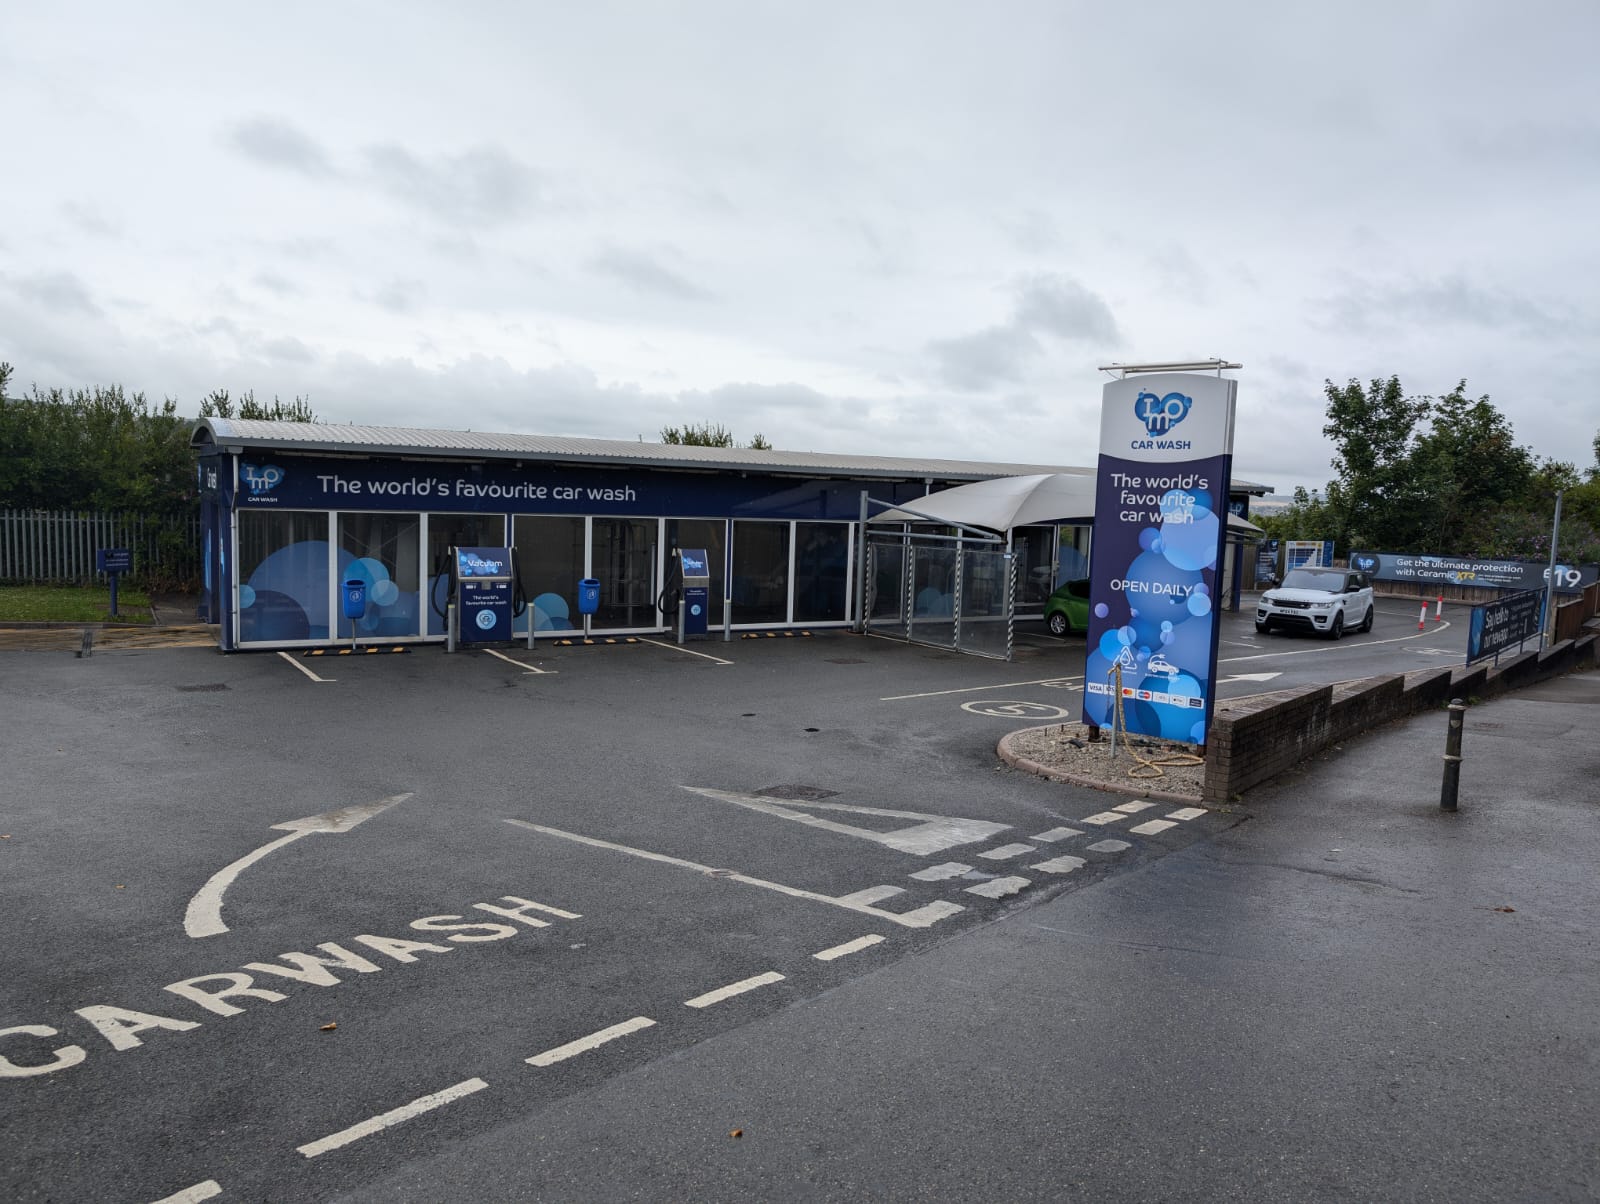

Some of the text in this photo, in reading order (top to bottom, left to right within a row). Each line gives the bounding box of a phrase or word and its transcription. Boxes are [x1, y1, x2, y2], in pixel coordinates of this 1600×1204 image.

[1131, 440, 1191, 449] CAR WASH
[317, 474, 636, 501] The world's favourite car wash
[1110, 473, 1208, 489] The world's
[1120, 490, 1196, 507] favourite
[1120, 510, 1194, 524] car wash
[1396, 558, 1413, 567] Get
[1431, 561, 1471, 570] ultimate
[1472, 564, 1524, 573] protection
[1395, 568, 1415, 576] with
[1417, 570, 1455, 579] Ceramic
[1456, 571, 1476, 581] XTR
[1110, 579, 1193, 597] OPEN DAILY
[0, 896, 582, 1077] CARWASH
